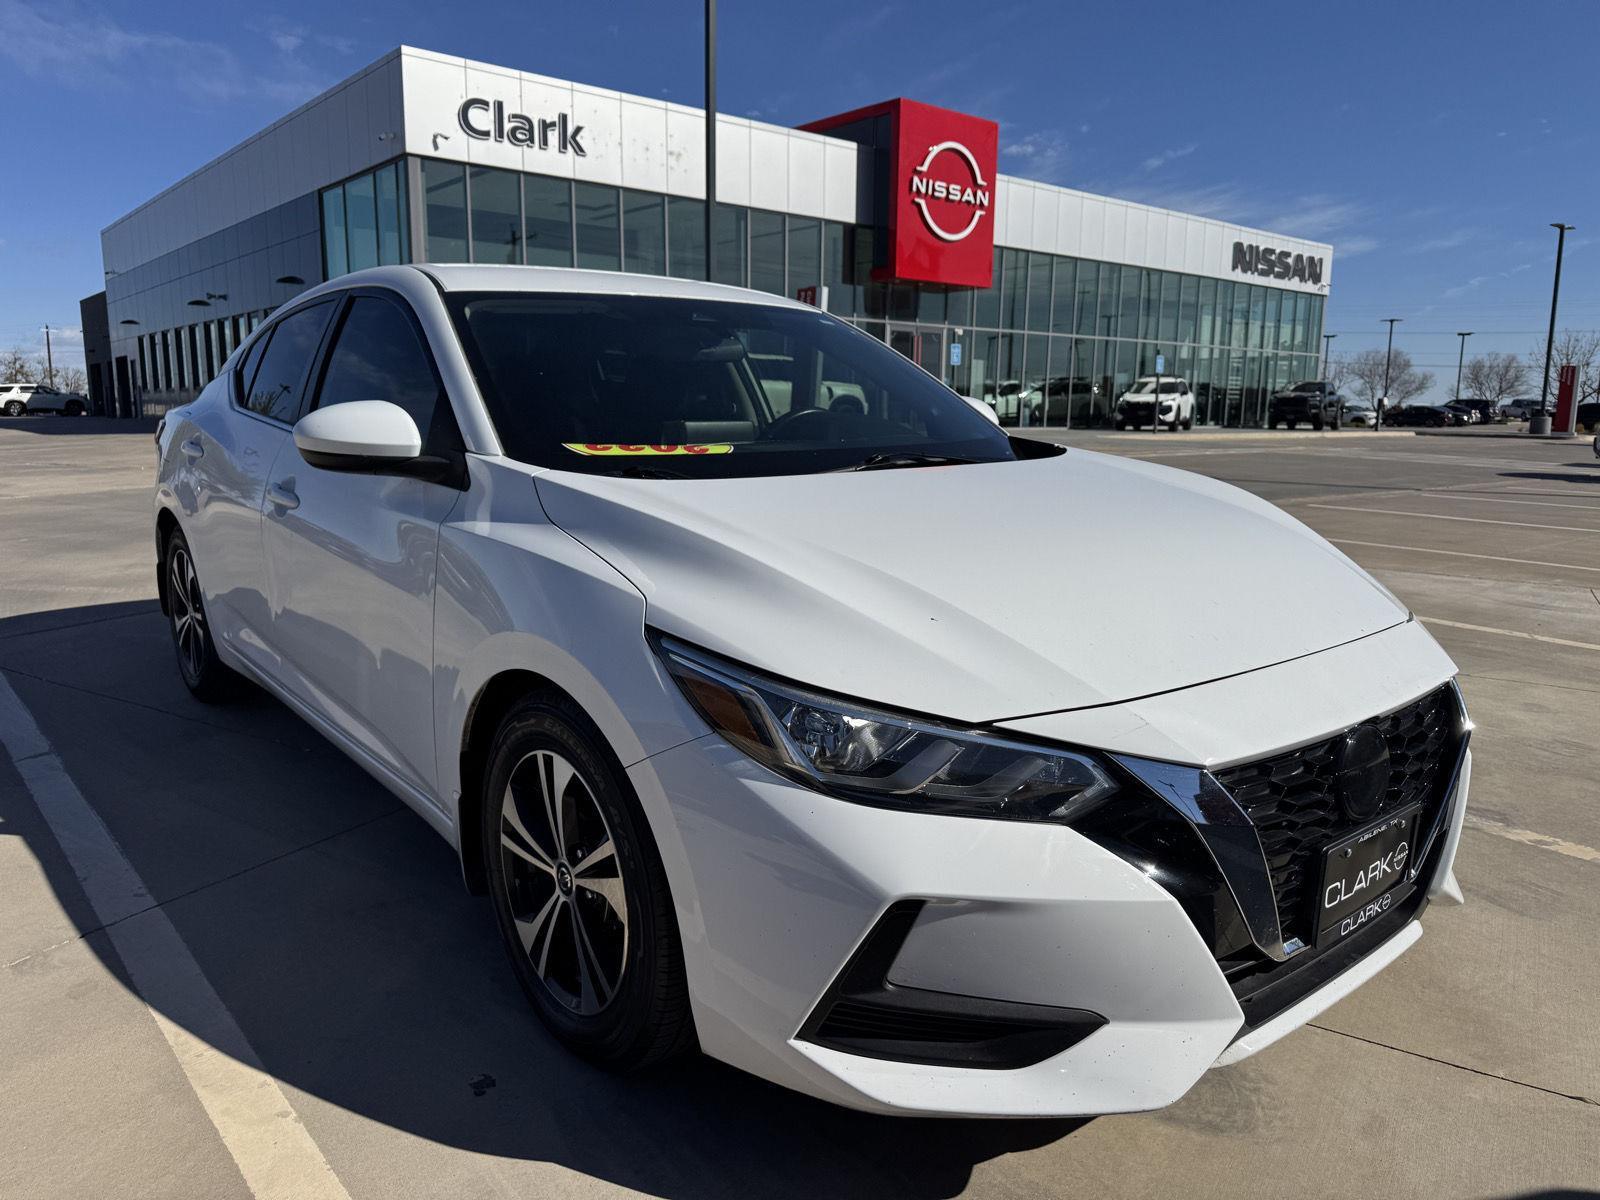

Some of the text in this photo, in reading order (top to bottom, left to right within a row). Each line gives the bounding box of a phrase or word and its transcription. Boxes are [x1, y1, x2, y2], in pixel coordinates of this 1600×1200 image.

[458, 97, 587, 157] Clark
[912, 175, 989, 207] NISSAN
[1231, 241, 1323, 285] NISSAN
[1324, 852, 1393, 908] CLARK
[1340, 899, 1382, 936] CLARK
